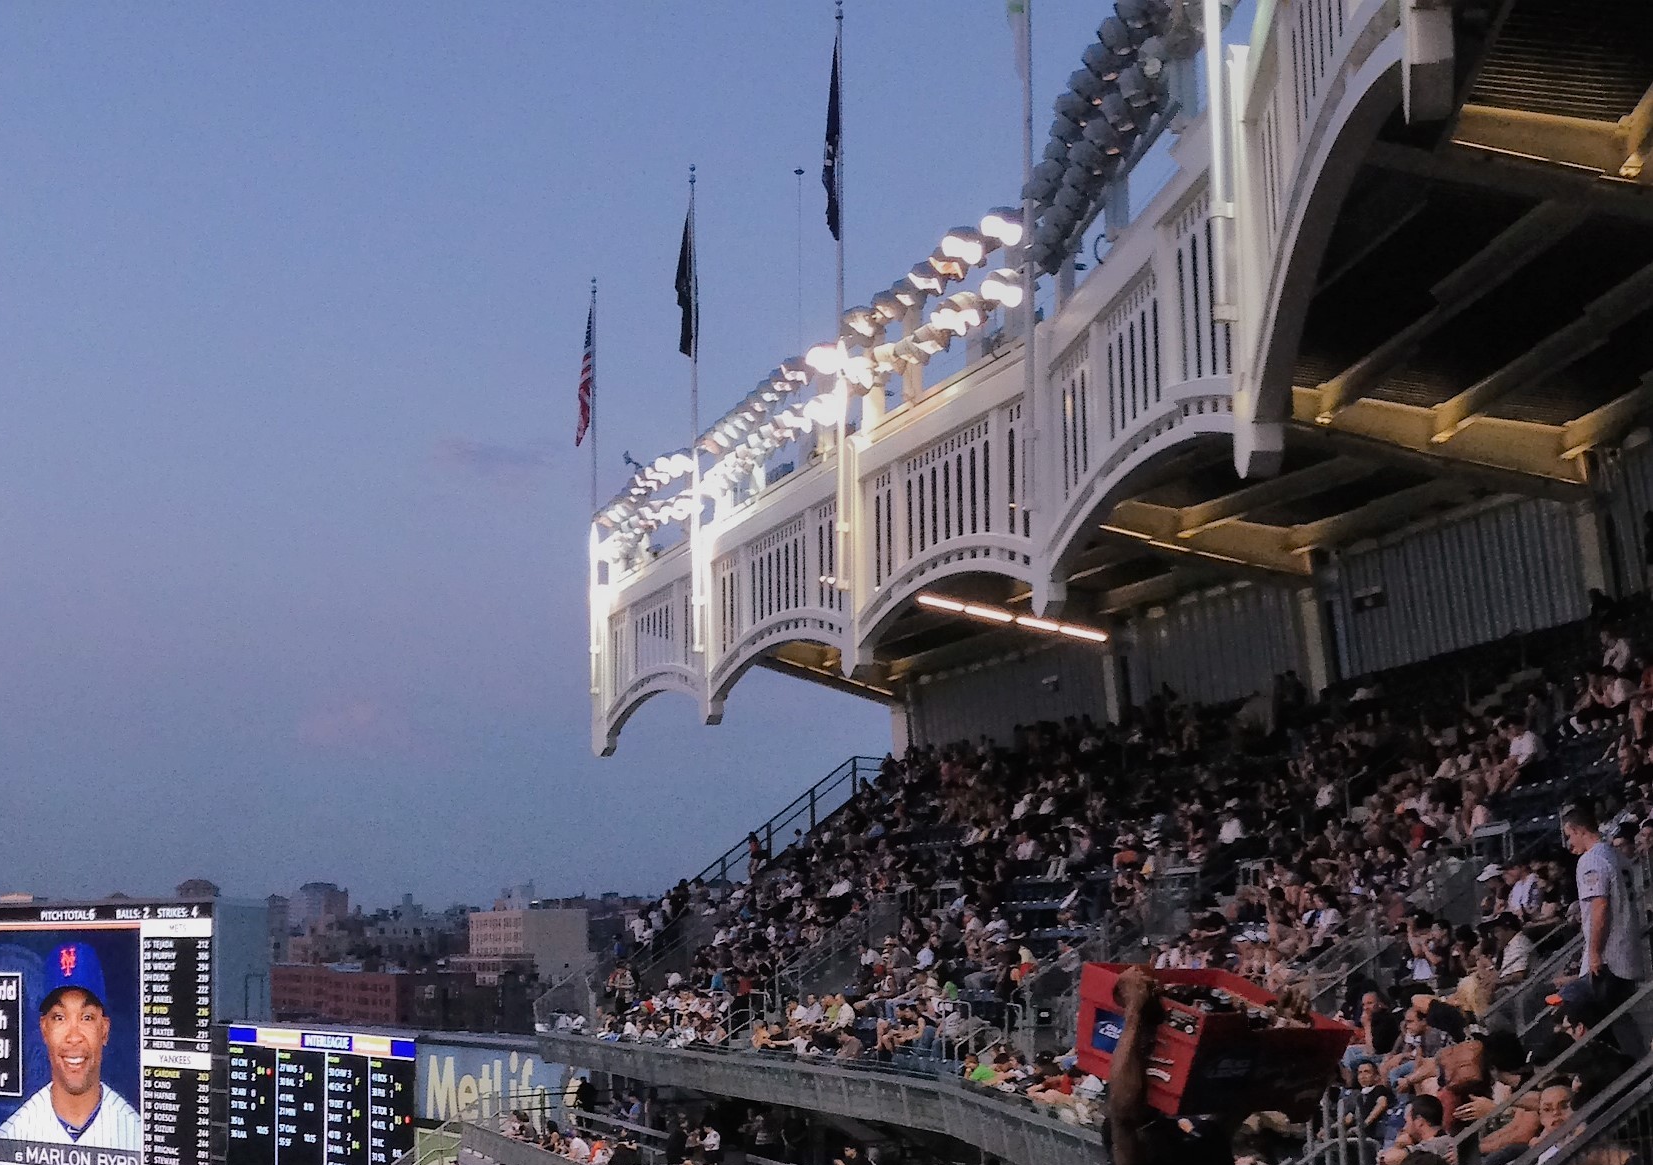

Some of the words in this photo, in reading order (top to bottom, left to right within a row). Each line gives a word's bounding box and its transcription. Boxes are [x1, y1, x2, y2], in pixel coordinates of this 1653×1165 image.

[116, 909, 141, 919] BALLS:
[143, 908, 150, 919] 2
[157, 907, 189, 919] STRIKES:
[191, 906, 198, 918] 4
[159, 1054, 191, 1065] YANKEES
